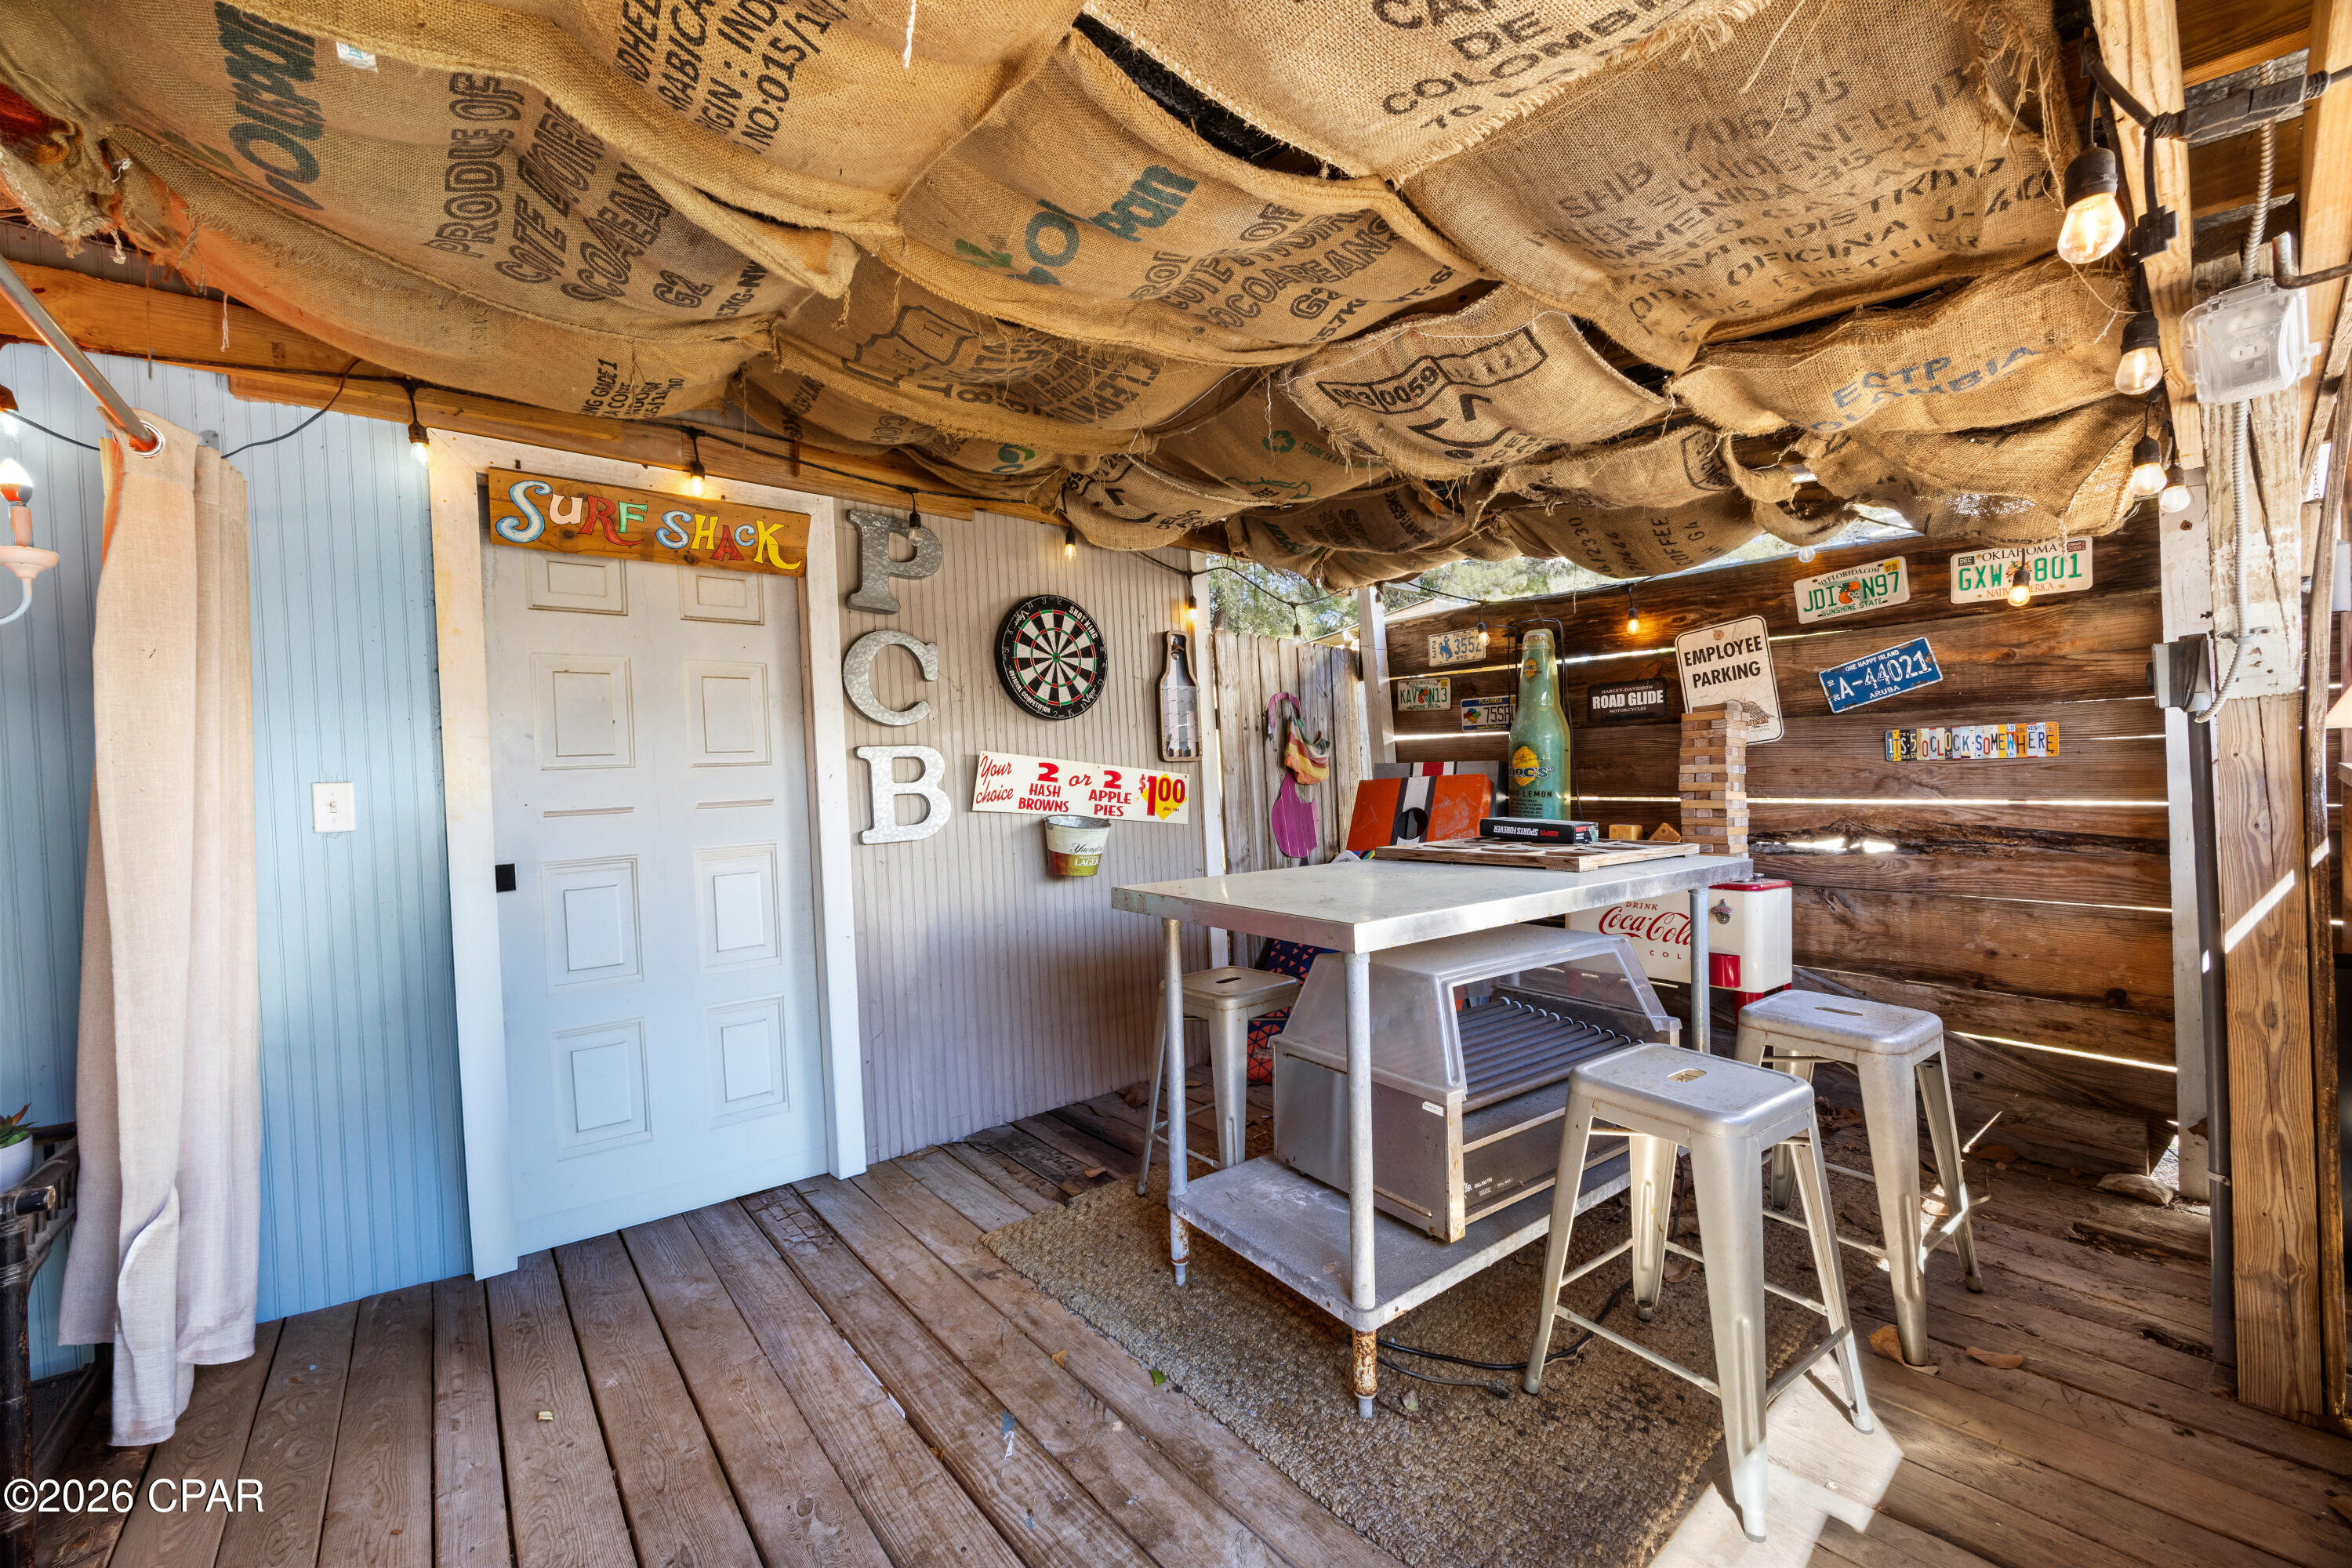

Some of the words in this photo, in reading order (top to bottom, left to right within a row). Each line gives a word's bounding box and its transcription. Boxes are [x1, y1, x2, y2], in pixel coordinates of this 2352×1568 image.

[1451, 10, 1552, 62] DE
[449, 71, 526, 121] OF
[1556, 159, 1653, 220] SHB
[1240, 202, 1308, 241] OF
[495, 191, 567, 283] COTE
[1726, 219, 1910, 288] OFICINA
[653, 270, 714, 308] G2
[495, 480, 648, 546] SURF
[655, 510, 802, 571] SHACK
[1651, 515, 1693, 566] COFFEE
[1959, 557, 1973, 566] DEC
[1959, 564, 2003, 591] GXW
[2034, 554, 2082, 582] 801
[1863, 572, 1901, 597] N97
[1987, 587, 2012, 598] NATIV
[1820, 601, 1857, 617] SUNSHINE
[1859, 597, 1883, 609] STATE
[1069, 606, 1086, 622] SHOT
[1084, 619, 1099, 640] KING
[1683, 636, 1763, 666] EMPLOYEE
[1845, 662, 1858, 673] ONE
[1858, 656, 1878, 670] HAPPY
[1878, 649, 1900, 661] ISLAND
[1692, 660, 1762, 688] PARKING
[1009, 670, 1022, 694] OFFICIAL
[1021, 691, 1051, 713] COMPETITION
[1592, 692, 1625, 710] ROAD
[1628, 689, 1664, 706] GLIDE
[1601, 684, 1653, 695] HARLEY-DAVIDSON
[1869, 684, 1900, 700] ARUBA
[1609, 706, 1647, 714] MOTORCYCLES
[980, 755, 1012, 779] Your
[1037, 762, 1059, 782] 2
[1069, 771, 1092, 787] or
[1103, 771, 1122, 789] 2
[976, 785, 1014, 805] choice
[1029, 783, 1062, 798] HASH
[1088, 789, 1132, 804] APPLE
[1018, 797, 1069, 813] BROWNS
[1094, 803, 1124, 817] PIES
[1493, 825, 1517, 834] FOREVER
[1517, 826, 1539, 837] SPORTS
[1625, 902, 1658, 911] DRINK
